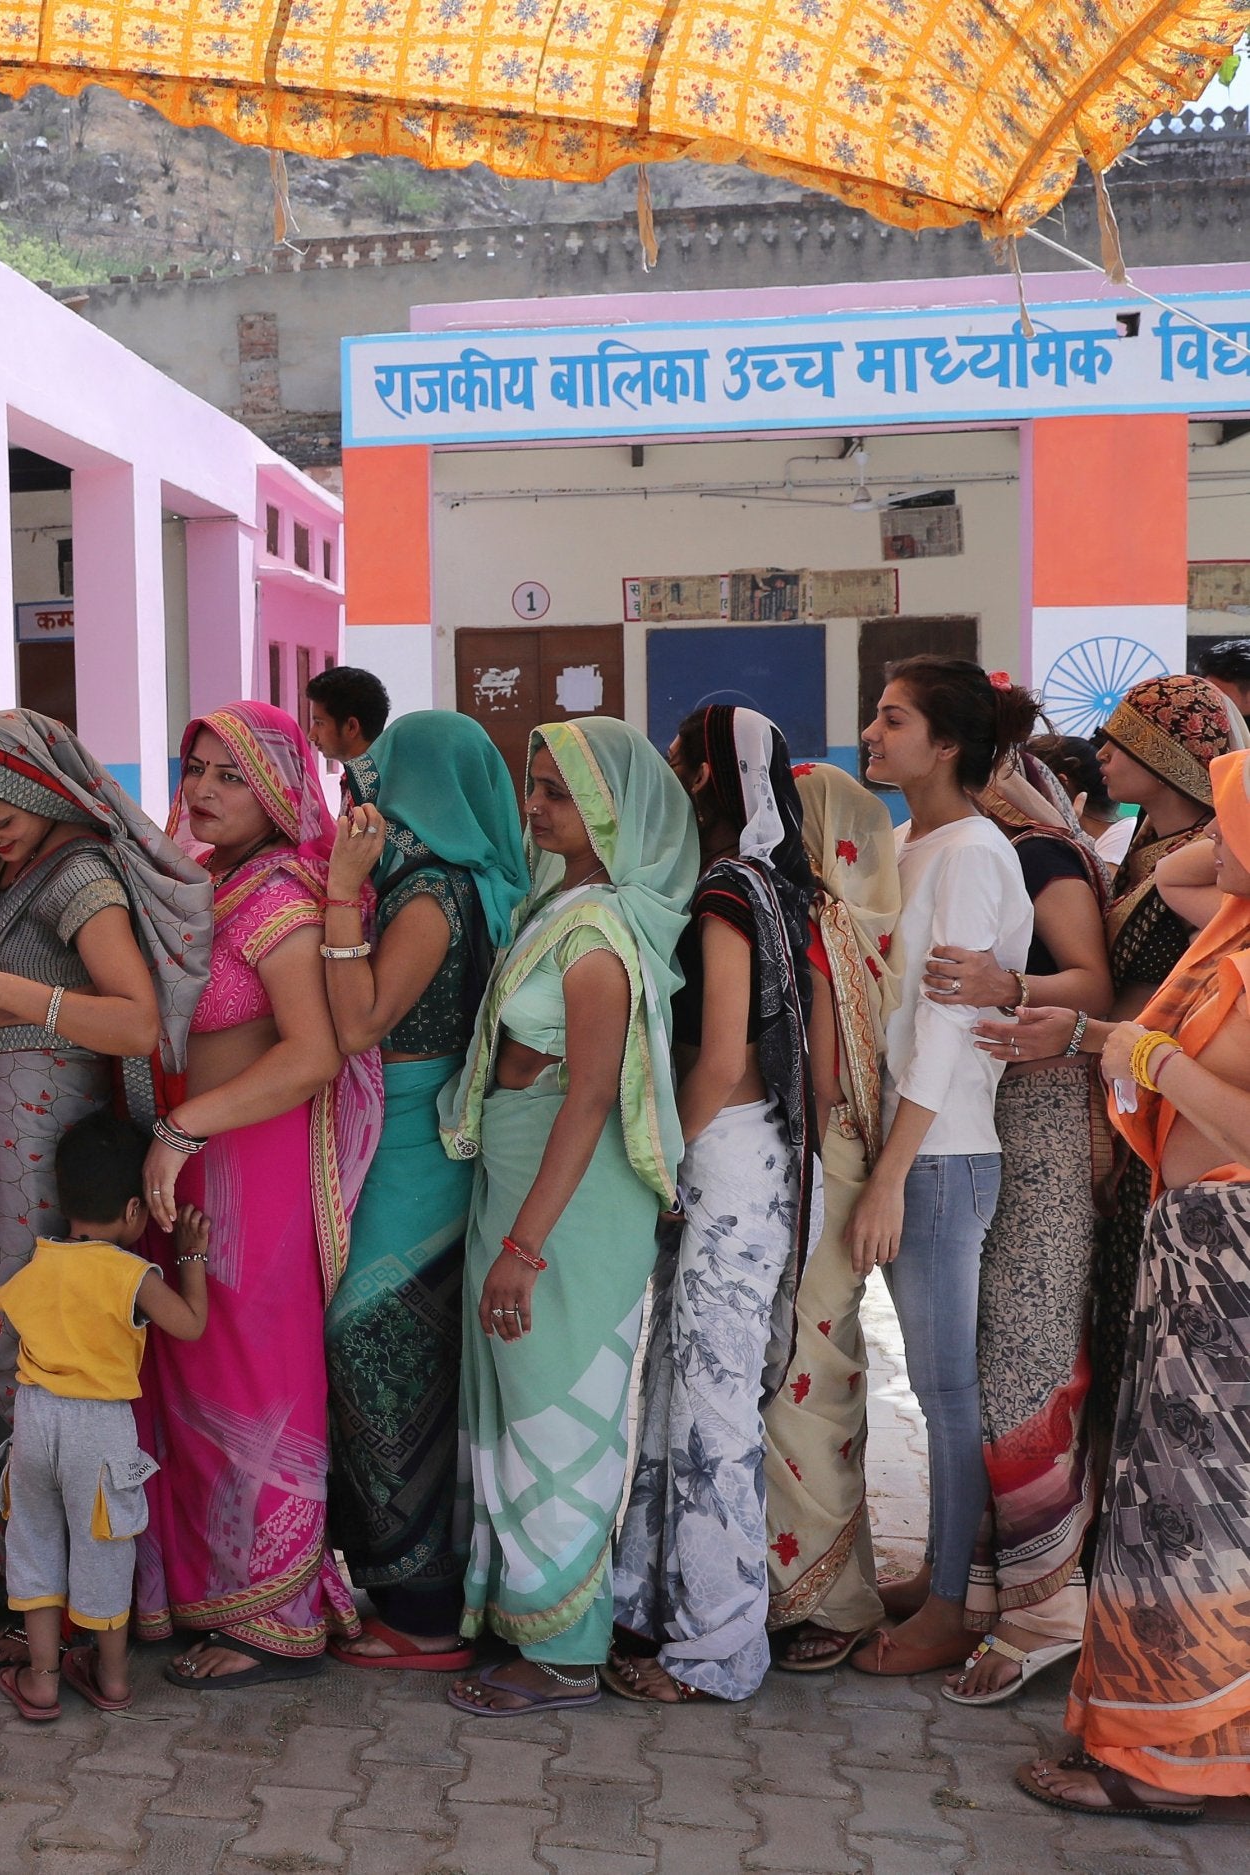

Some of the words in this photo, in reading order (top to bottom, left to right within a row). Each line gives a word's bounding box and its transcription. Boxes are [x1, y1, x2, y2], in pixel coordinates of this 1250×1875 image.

[374, 348, 538, 419] राजकीय
[550, 339, 710, 411] बालिका
[723, 340, 843, 401] उच्च
[855, 319, 1117, 393] माध्यमिक
[527, 591, 537, 612] 1
